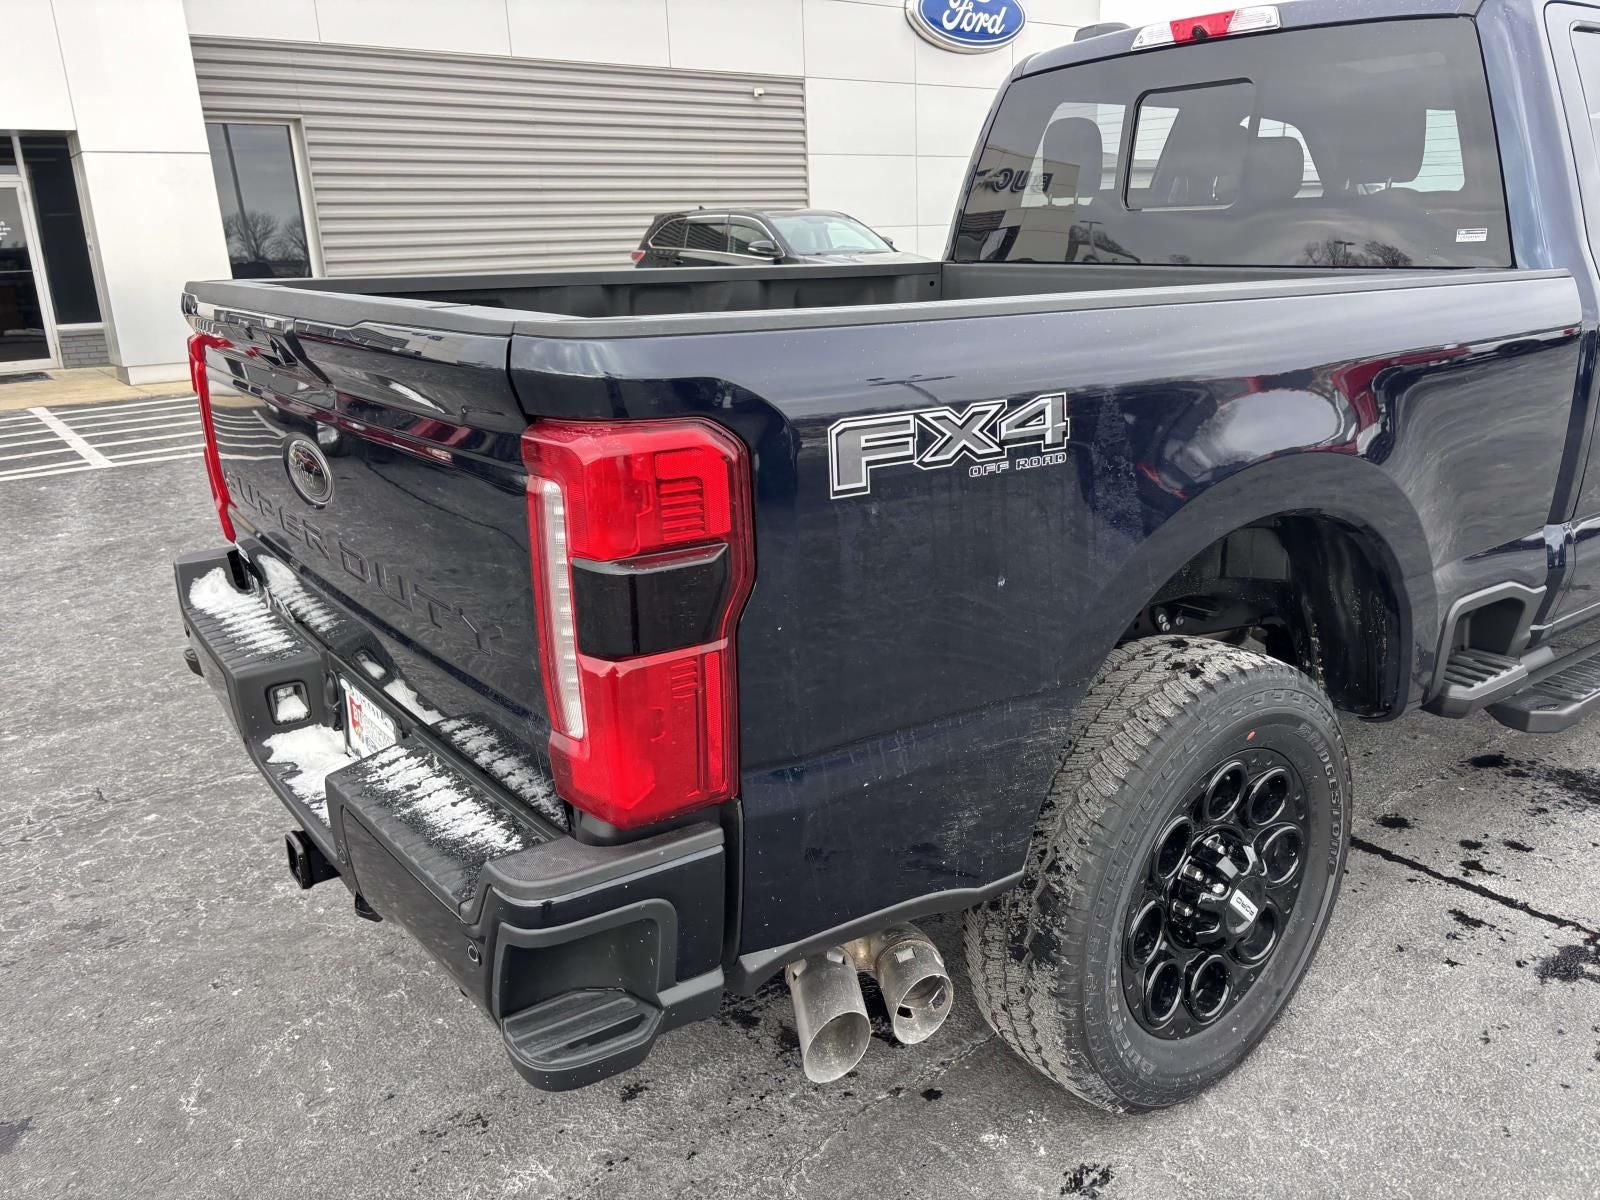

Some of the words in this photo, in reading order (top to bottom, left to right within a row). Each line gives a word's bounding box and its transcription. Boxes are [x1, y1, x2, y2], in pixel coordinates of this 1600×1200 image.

[942, 0, 1007, 35] Ford
[828, 392, 1070, 500] FX4
[968, 460, 1009, 479] OFF
[1015, 451, 1067, 472] ROAD
